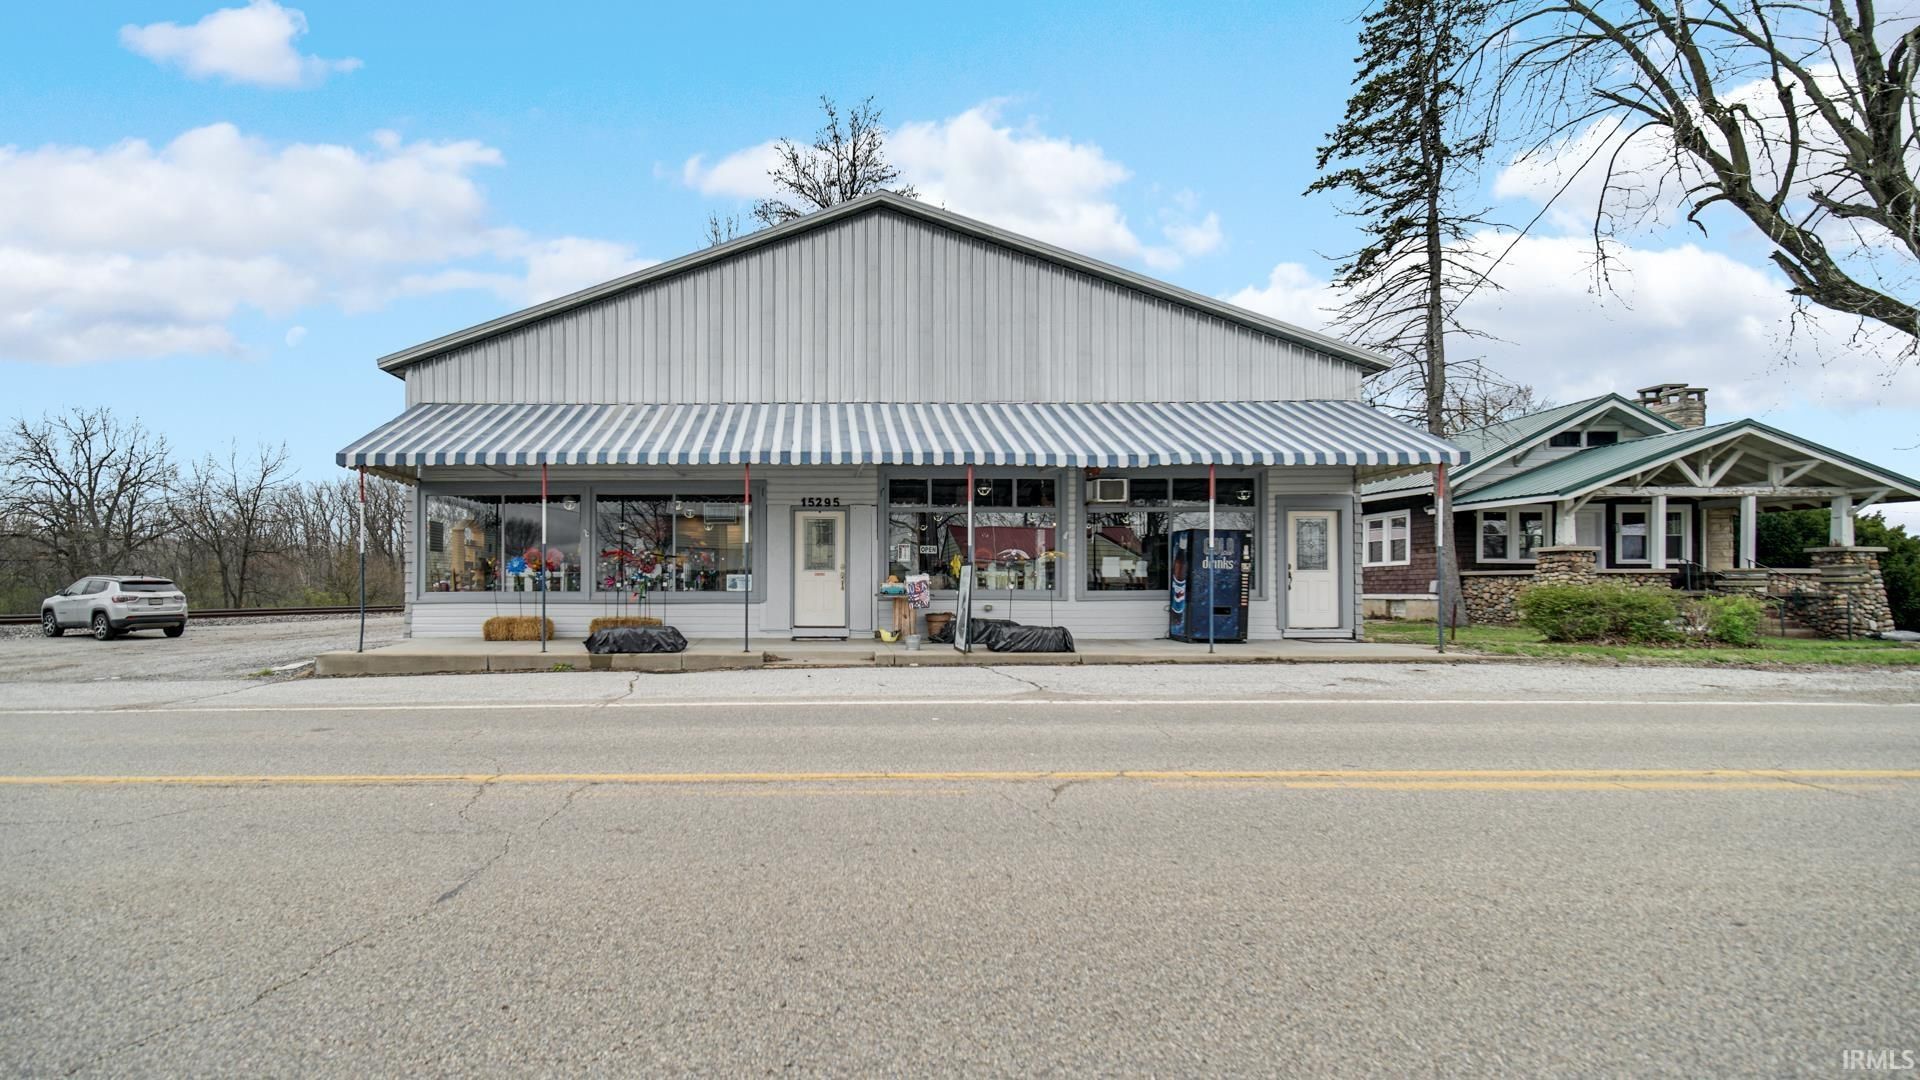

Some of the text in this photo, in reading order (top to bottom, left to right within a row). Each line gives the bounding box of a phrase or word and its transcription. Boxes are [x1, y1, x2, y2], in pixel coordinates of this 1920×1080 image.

[801, 497, 840, 507] 15295
[1202, 556, 1234, 569] drinks
[908, 581, 928, 593] USA
